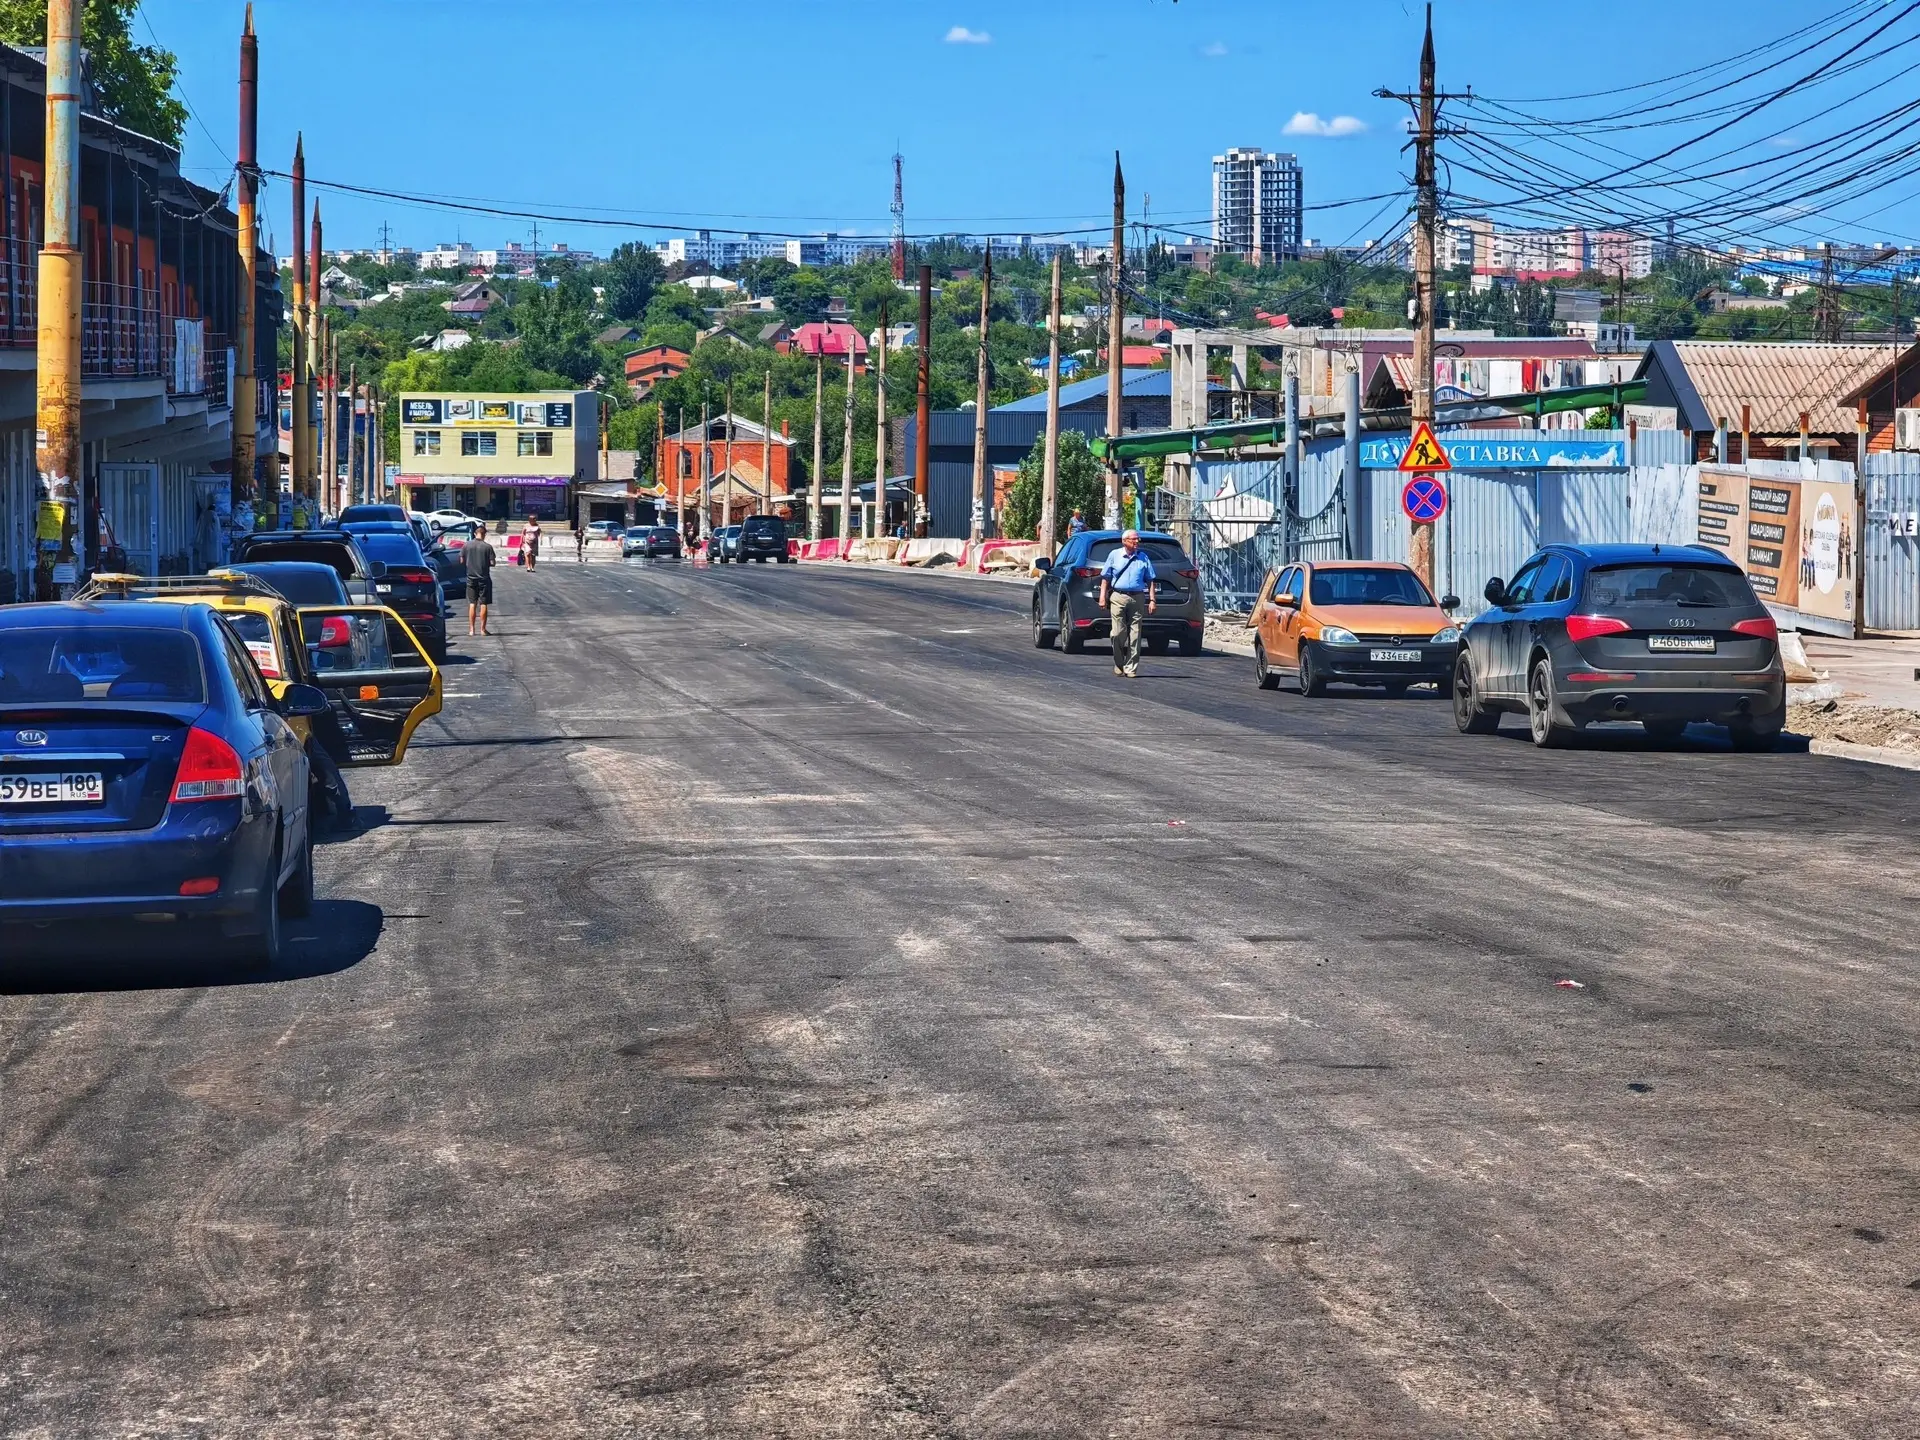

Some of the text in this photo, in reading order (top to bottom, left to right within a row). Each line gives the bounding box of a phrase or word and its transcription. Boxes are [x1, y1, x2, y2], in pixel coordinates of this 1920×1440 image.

[409, 402, 434, 410] МЕБЕЛЬ
[1749, 548, 1774, 563] ЛАМИНАТ
[20, 732, 43, 741] KIA
[64, 775, 97, 792] 180
